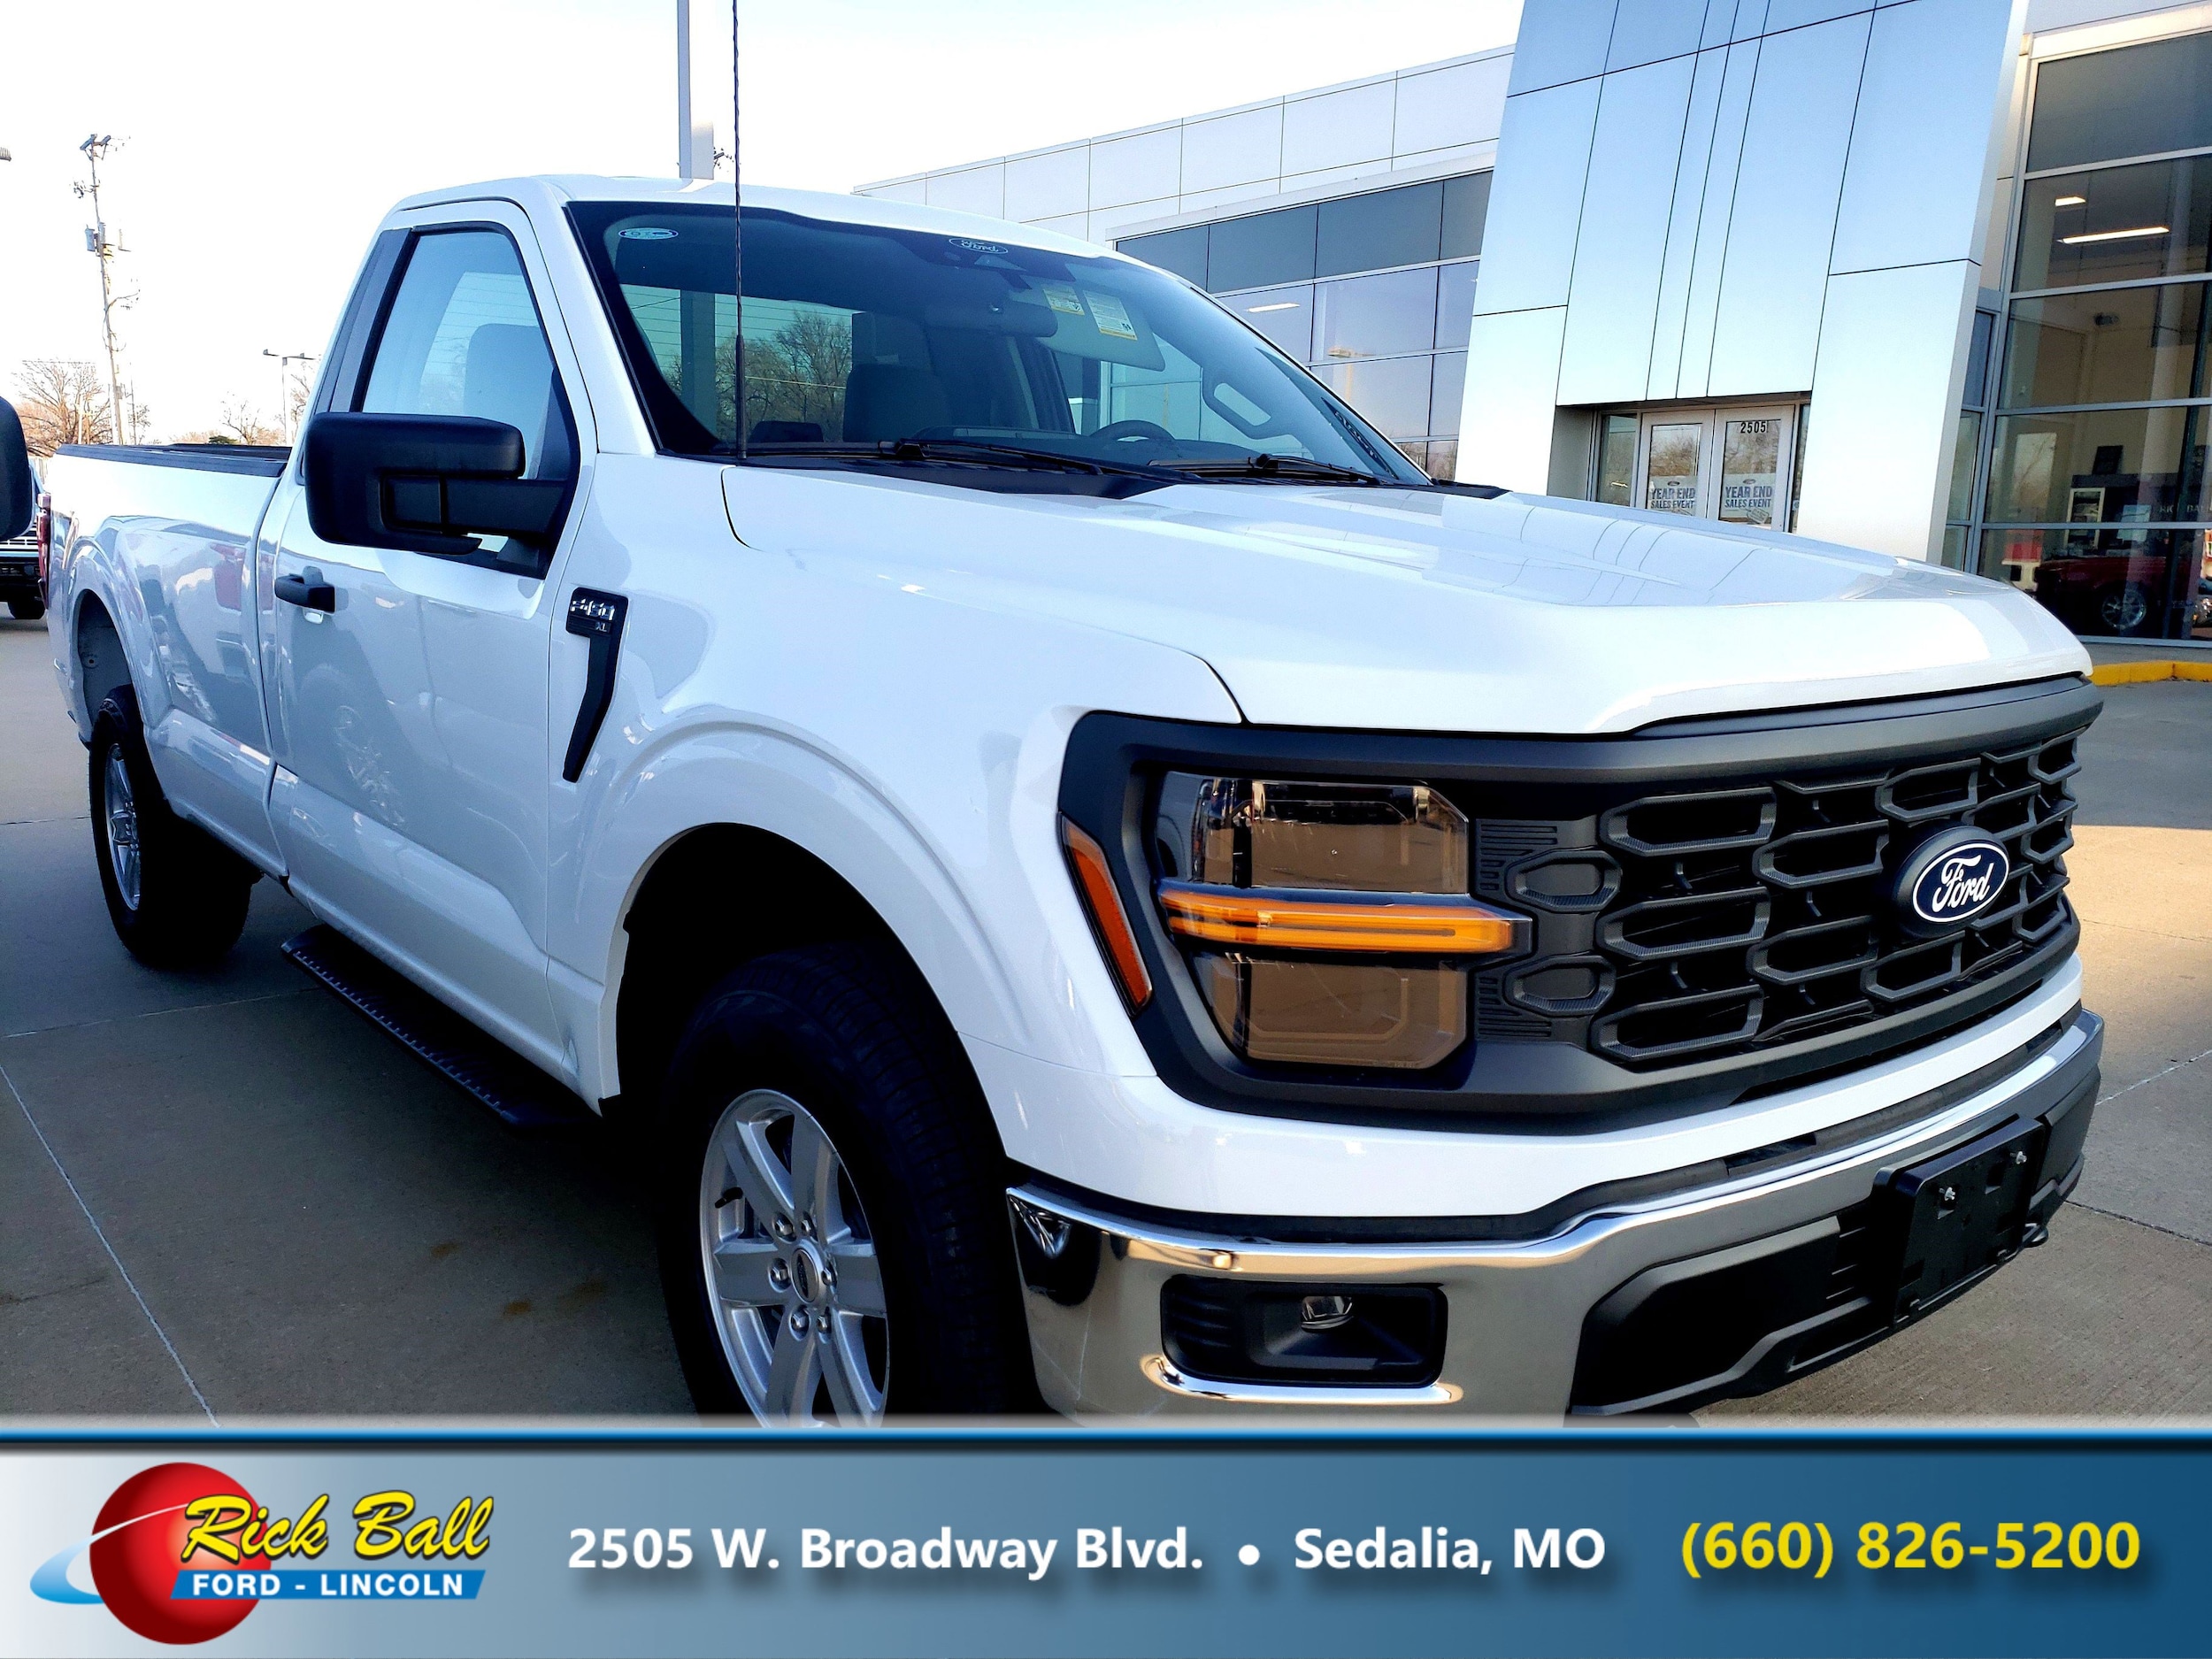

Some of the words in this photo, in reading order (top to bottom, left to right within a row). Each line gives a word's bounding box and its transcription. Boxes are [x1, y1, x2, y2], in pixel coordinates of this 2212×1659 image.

[961, 240, 998, 252] Ford
[1741, 421, 1766, 434] 2505
[1652, 488, 1676, 499] YEAR
[1677, 488, 1695, 499] END
[1724, 487, 1750, 498] YEAR
[1754, 486, 1772, 497] END
[1651, 500, 1671, 509] SALES
[1672, 500, 1695, 509] EVENT
[1724, 499, 1747, 508] SALES
[1748, 498, 1771, 507] EVENT
[1932, 854, 1994, 913] Ford
